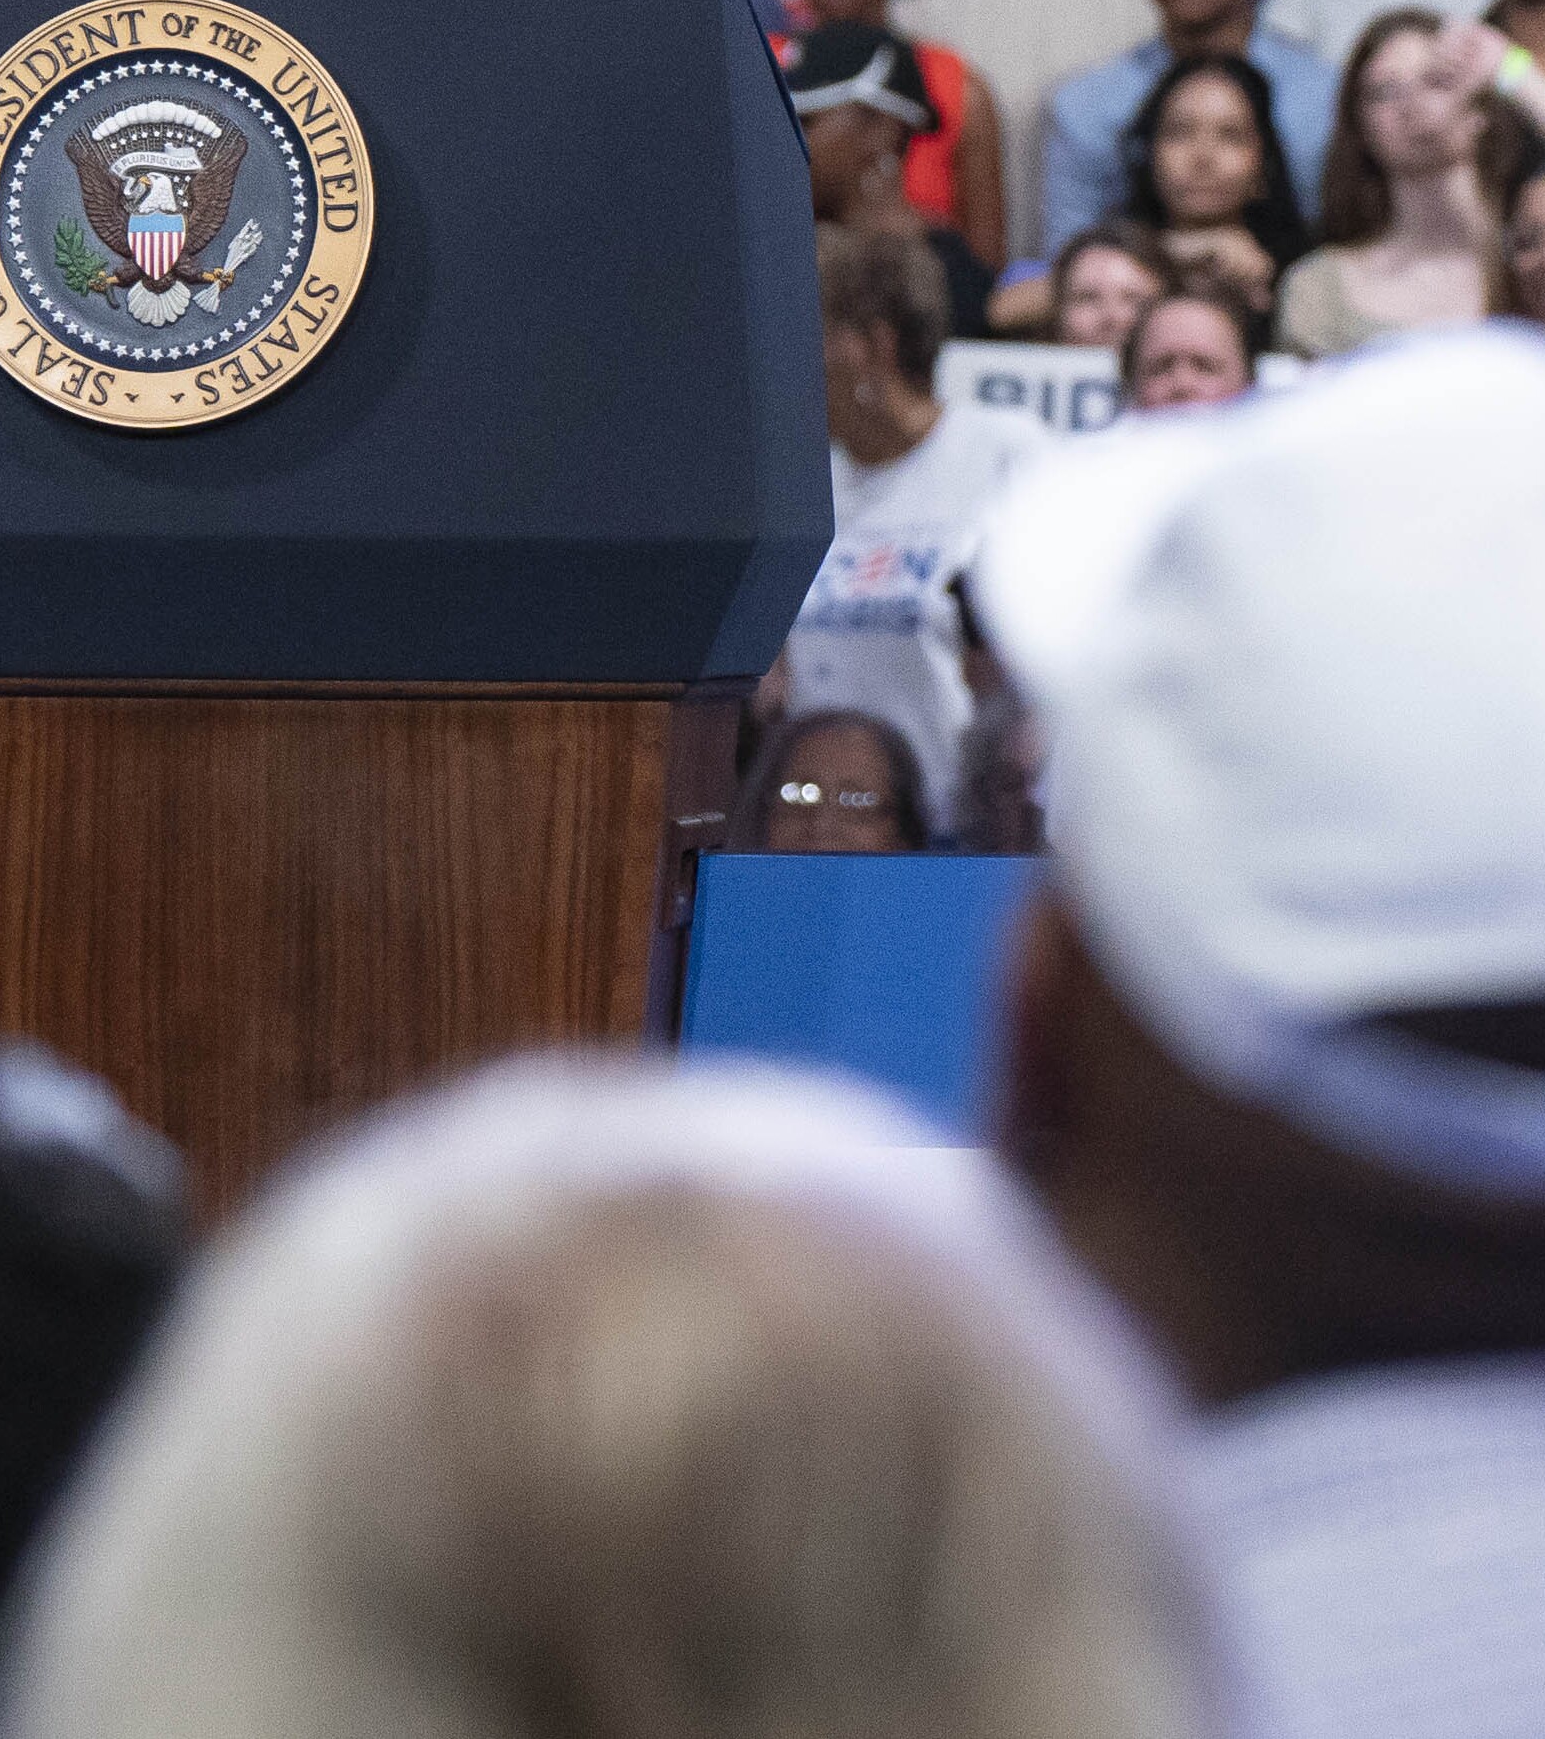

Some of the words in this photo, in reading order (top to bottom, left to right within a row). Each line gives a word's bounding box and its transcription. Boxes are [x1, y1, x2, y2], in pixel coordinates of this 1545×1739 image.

[161, 12, 199, 38] OF
[208, 20, 262, 62] THE
[271, 56, 359, 233] UNITED
[7, 318, 115, 406] SEAL
[194, 273, 340, 407] STATES
[976, 373, 1123, 432] BID
